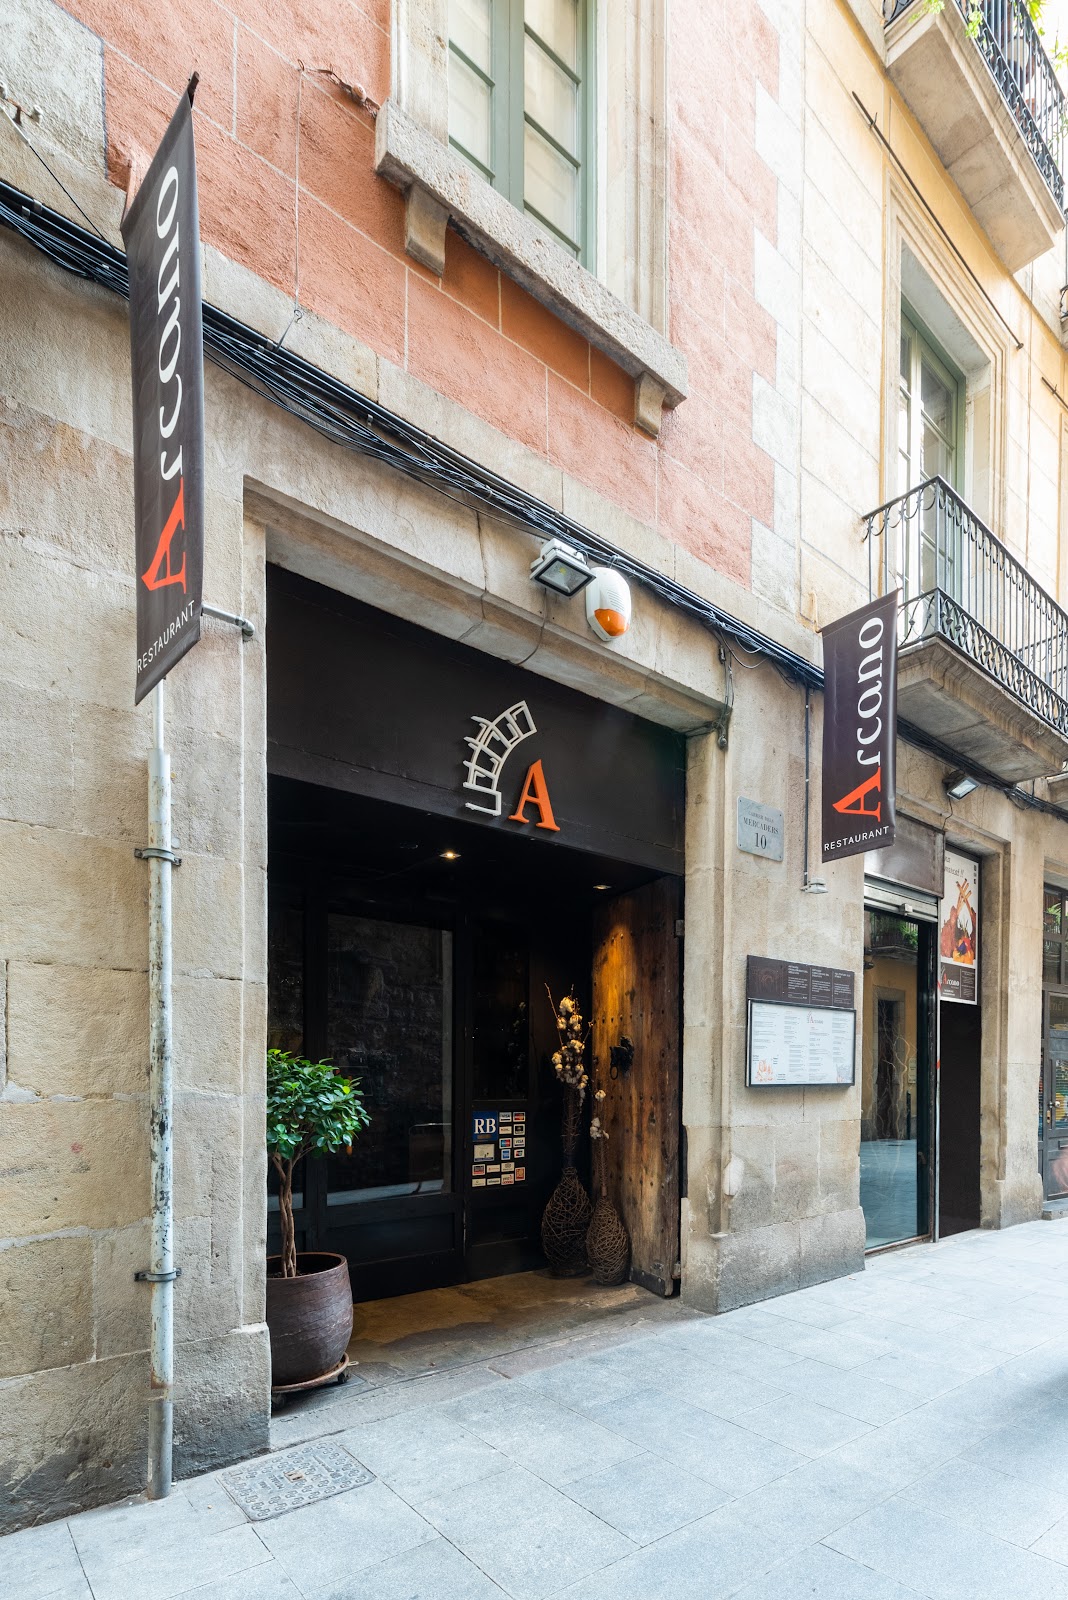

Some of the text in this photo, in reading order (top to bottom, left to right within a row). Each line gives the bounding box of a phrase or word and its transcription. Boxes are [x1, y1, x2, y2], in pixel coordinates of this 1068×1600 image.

[141, 165, 187, 594] Arcano
[136, 600, 195, 674] RESTAURANT
[832, 616, 884, 823] Arcano
[508, 758, 561, 832] A
[743, 816, 779, 834] MERCADERS
[754, 832, 767, 850] 10
[824, 825, 890, 852] RESTAURANT
[474, 1118, 496, 1134] RB
